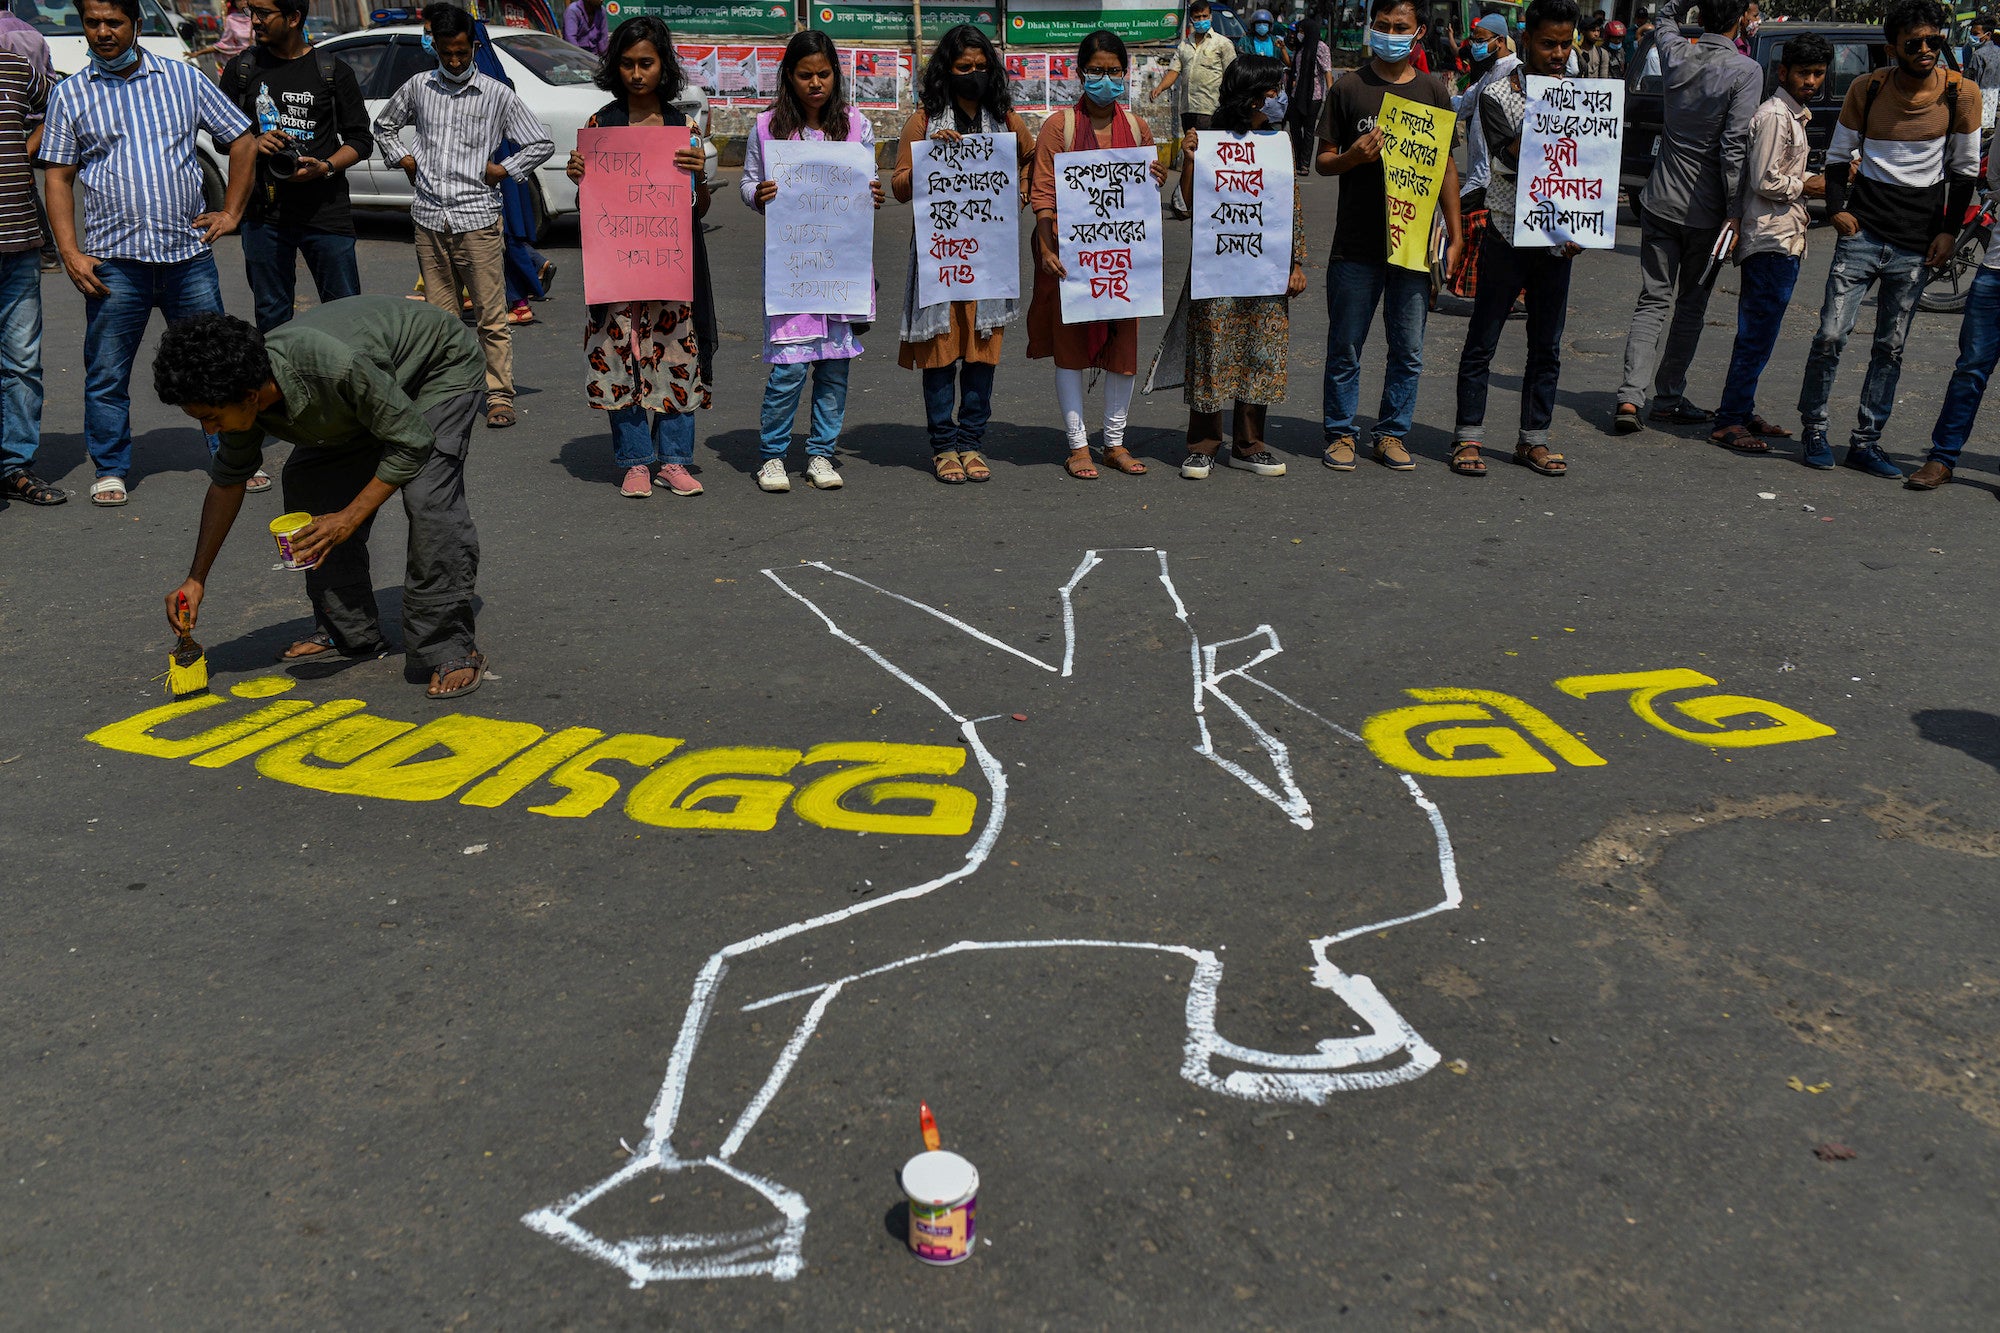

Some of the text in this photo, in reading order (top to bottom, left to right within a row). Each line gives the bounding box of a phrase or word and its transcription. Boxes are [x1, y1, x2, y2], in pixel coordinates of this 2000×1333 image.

[623, 6, 641, 15] ঢাকা
[837, 13, 854, 22] ঢাকা
[1071, 21, 1096, 29] Transit
[1097, 20, 1130, 29] Company
[1132, 20, 1159, 28] Limited
[1582, 89, 1611, 113] মার
[1386, 107, 1436, 140] এ লড়াই
[588, 137, 641, 177] বিচার
[1216, 141, 1256, 166] কথা
[1400, 138, 1438, 167] থাকার
[1543, 137, 1577, 177] খুনী
[628, 170, 684, 208] চাইনা
[928, 171, 1010, 195] কিশোরকে
[1063, 160, 1146, 192] মুশতাকের
[1215, 168, 1265, 197] চলবে
[1529, 174, 1602, 202] হাসিনার
[799, 186, 850, 216] গদিতে
[1088, 180, 1125, 219] খুনী
[595, 203, 679, 238] স্বৈরাচারের
[1211, 201, 1263, 227] কলম
[778, 223, 842, 244] আগুন
[1069, 220, 1146, 244] সরকারের
[1215, 232, 1263, 258] চলবে
[616, 237, 686, 273] পতন চাই
[929, 232, 979, 261] বাঁচতে
[1078, 248, 1133, 273] পতন
[939, 264, 975, 287] দাও
[1089, 270, 1131, 302] চাই
[780, 280, 860, 302] একসাথে
